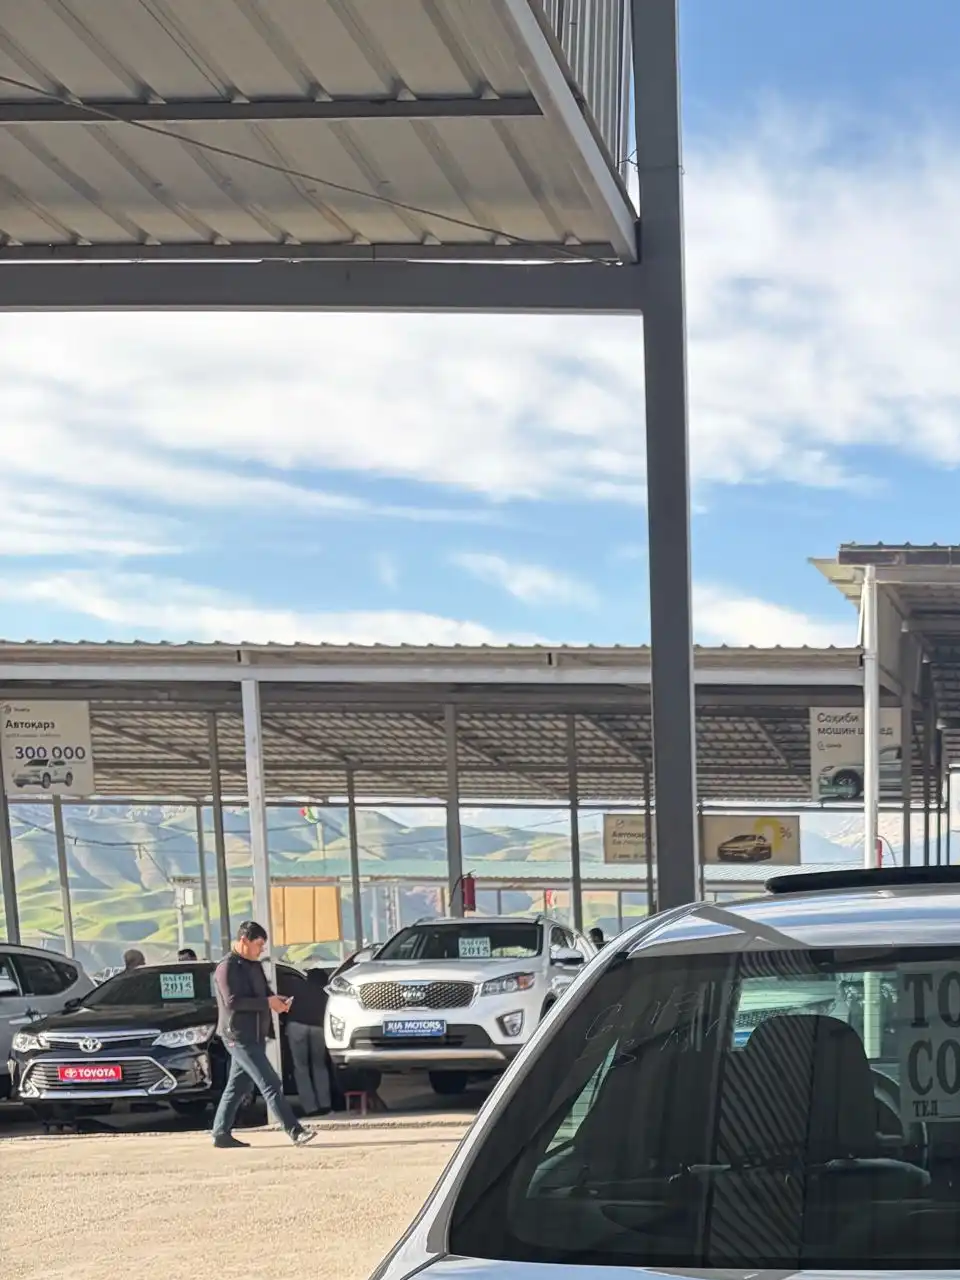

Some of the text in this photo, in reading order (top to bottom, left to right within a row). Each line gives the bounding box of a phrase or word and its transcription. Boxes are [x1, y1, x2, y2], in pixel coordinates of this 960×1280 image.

[818, 727, 893, 736] мошин шед
[15, 746, 86, 759] 300 000
[79, 1068, 116, 1078] TOYOTA
